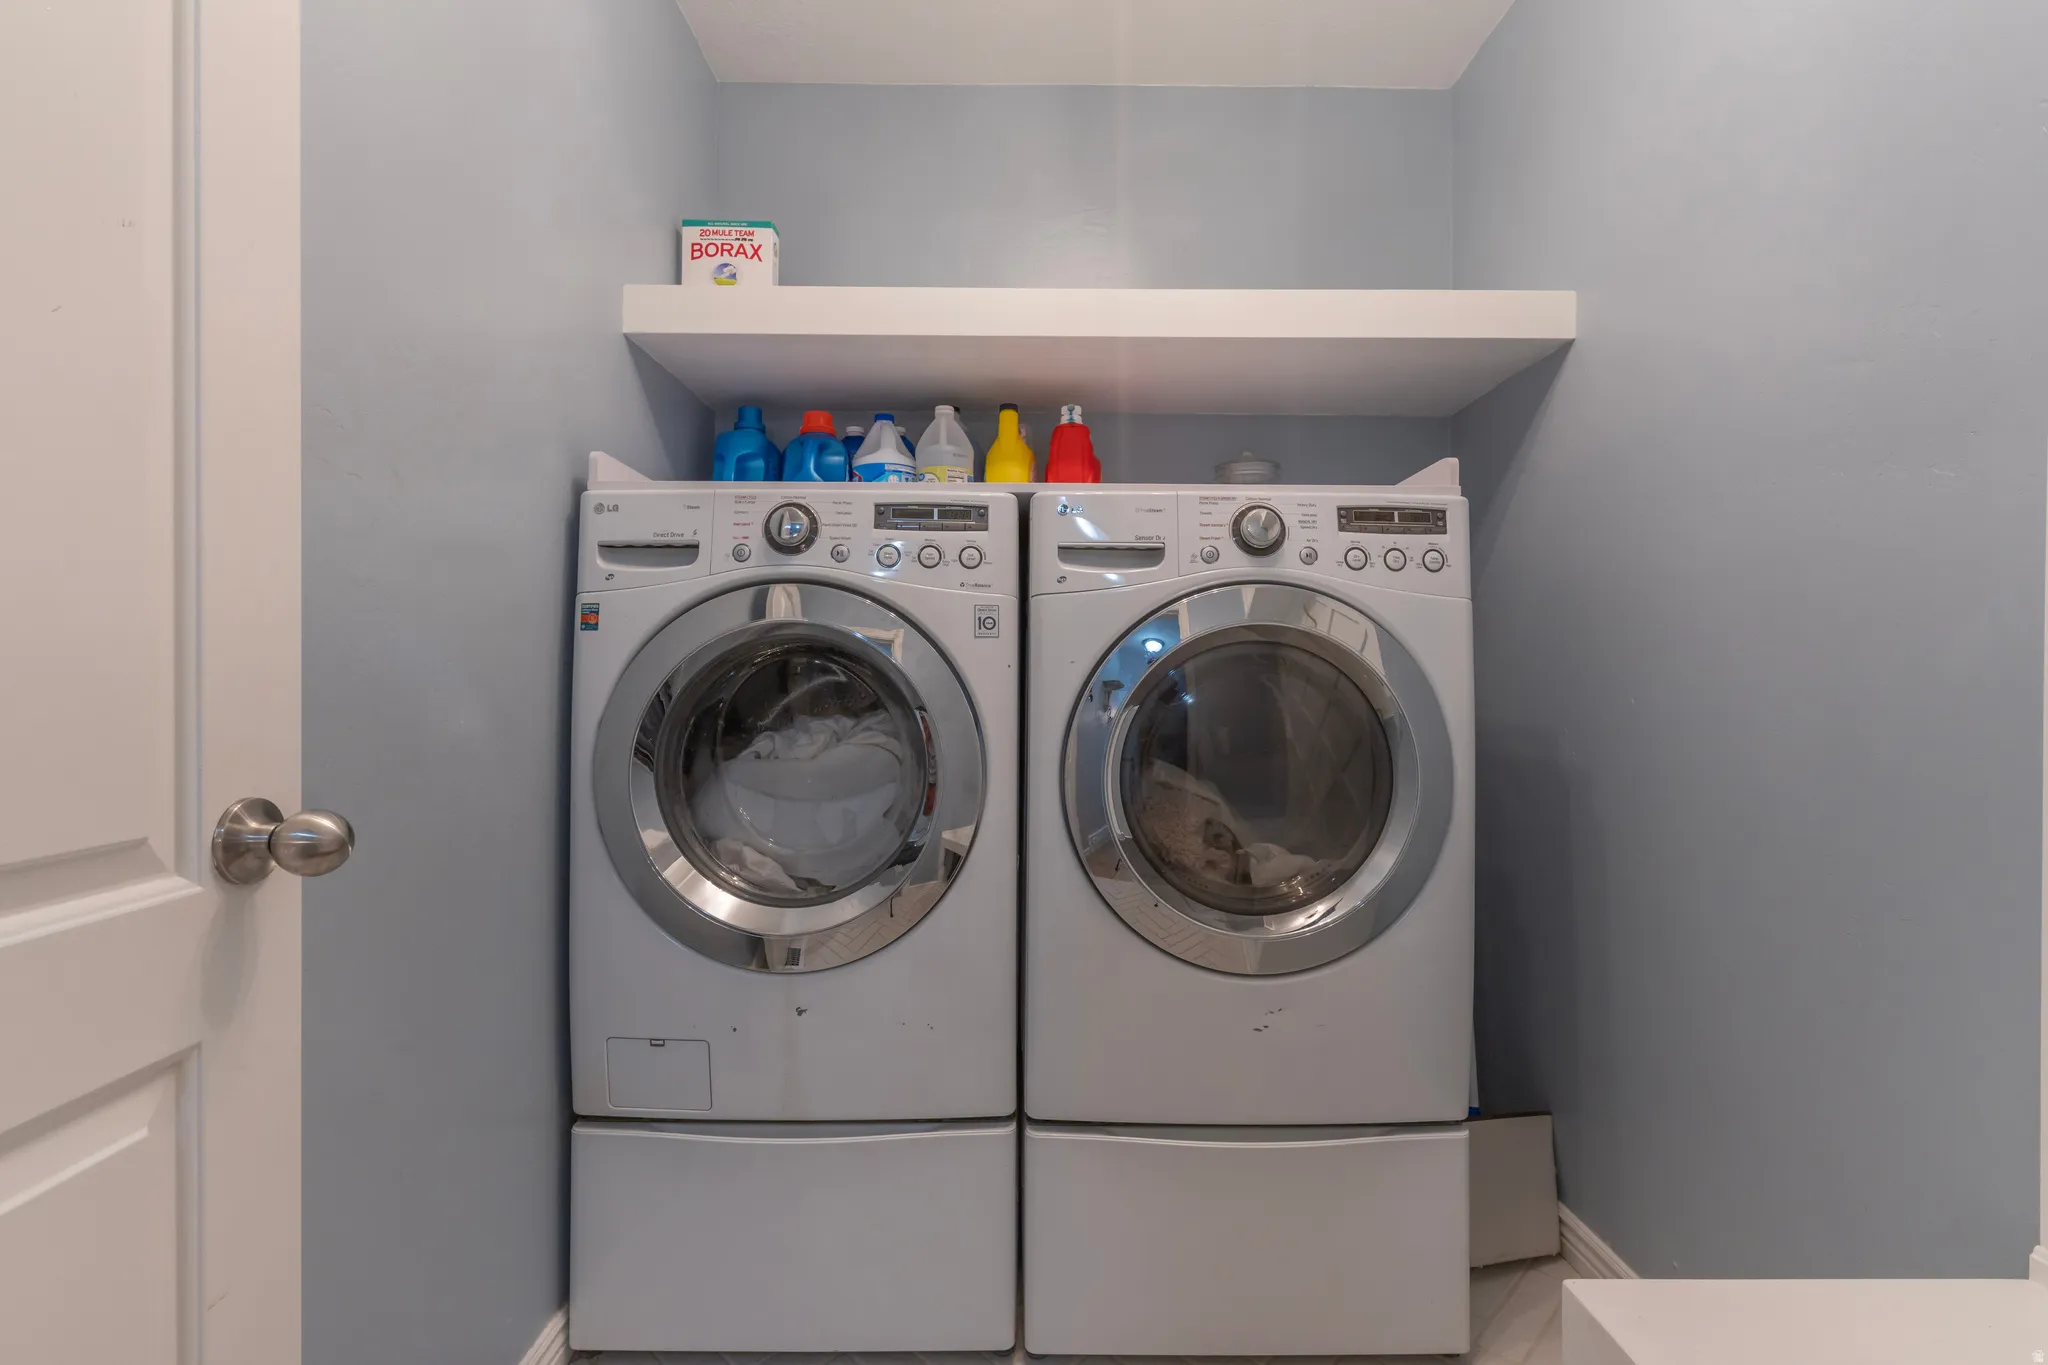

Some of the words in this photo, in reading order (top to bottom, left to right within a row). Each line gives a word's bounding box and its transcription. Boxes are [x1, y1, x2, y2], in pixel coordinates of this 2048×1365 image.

[699, 229, 711, 237] 20
[712, 229, 733, 237] MULE
[691, 242, 763, 262] BORAX
[606, 504, 620, 512] LG
[977, 616, 997, 631] 10
